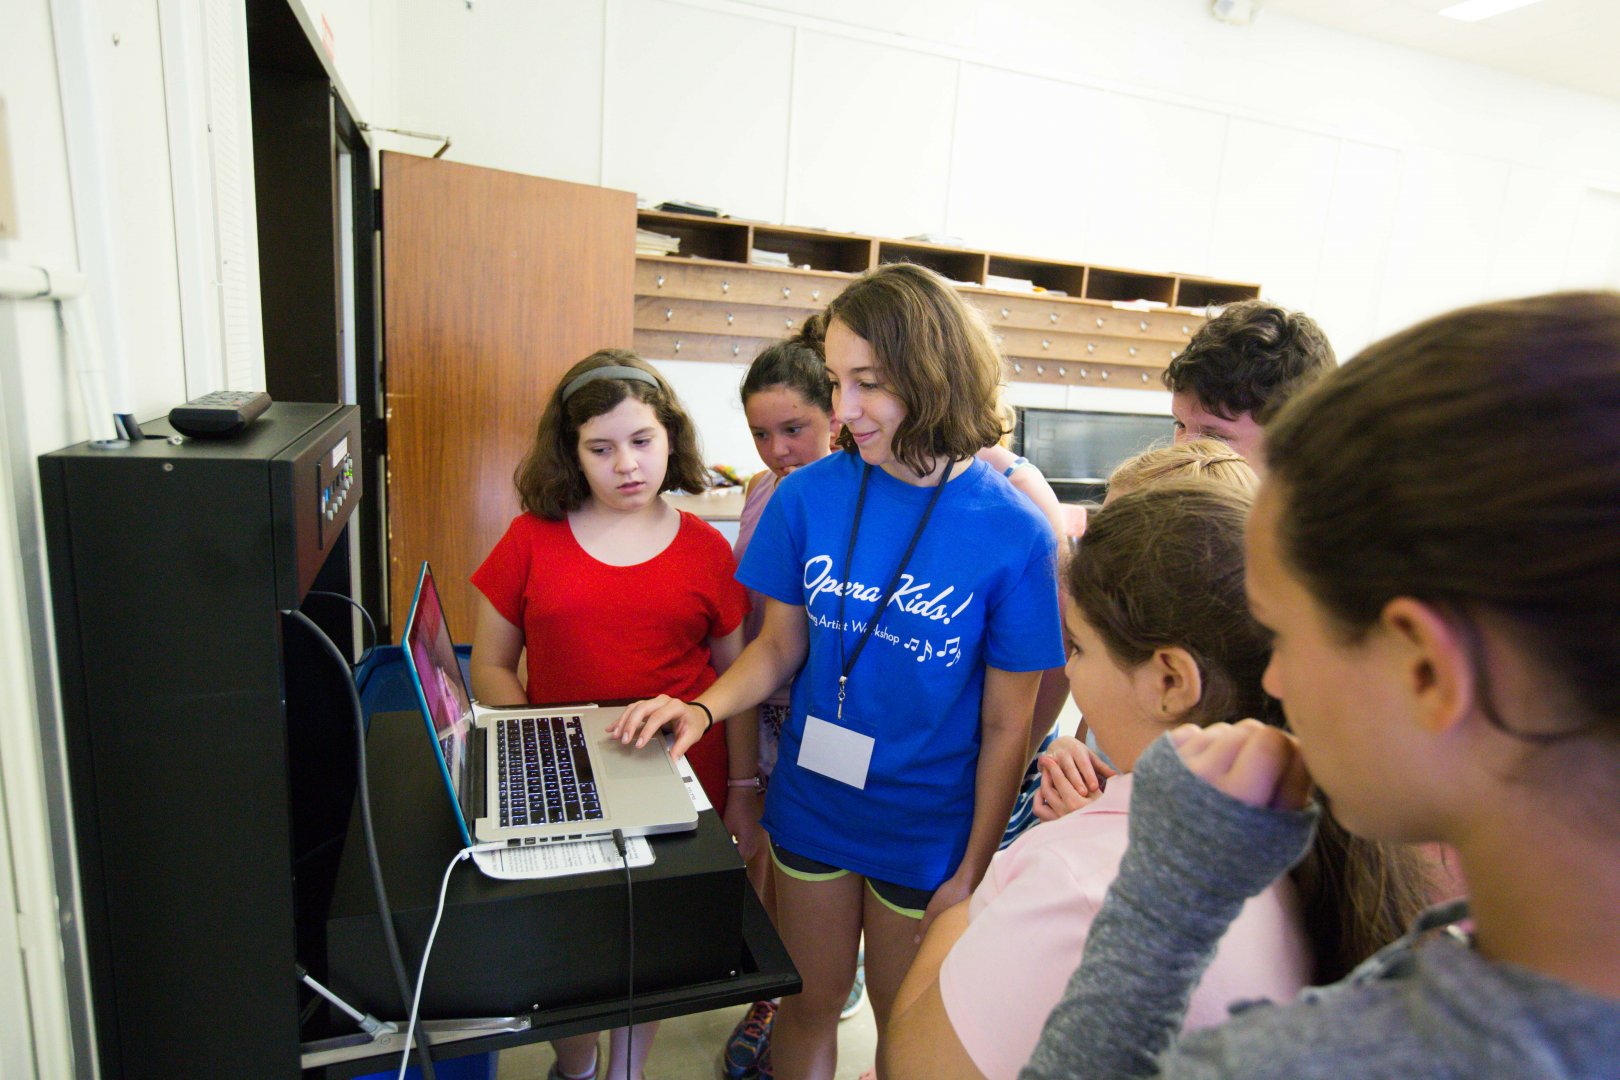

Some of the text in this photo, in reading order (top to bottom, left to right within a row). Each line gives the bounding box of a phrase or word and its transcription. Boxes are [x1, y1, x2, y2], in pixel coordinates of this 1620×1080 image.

[803, 554, 974, 625] Opera Kids!
[851, 619, 900, 646] Wkshop
